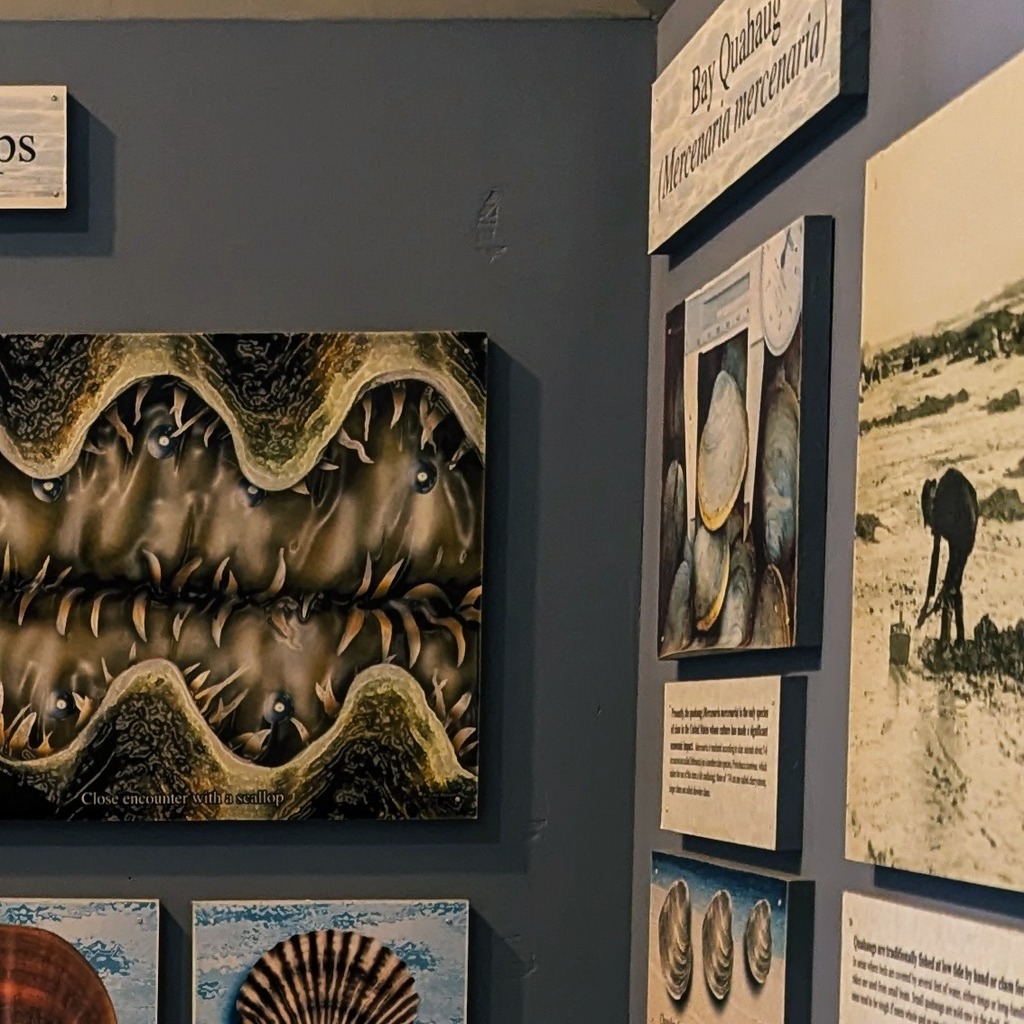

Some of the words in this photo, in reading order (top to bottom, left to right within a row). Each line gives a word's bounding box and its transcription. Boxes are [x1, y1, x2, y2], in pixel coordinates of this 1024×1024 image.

[657, 100, 731, 213] (Mercenaria
[734, 0, 829, 134] mercenaria)
[690, 60, 715, 115] Bay
[718, 0, 782, 90] Quahaug
[81, 791, 118, 806] Close
[122, 792, 188, 806] encounter
[193, 791, 222, 805] with
[224, 795, 233, 805] a
[235, 790, 284, 806] scallop
